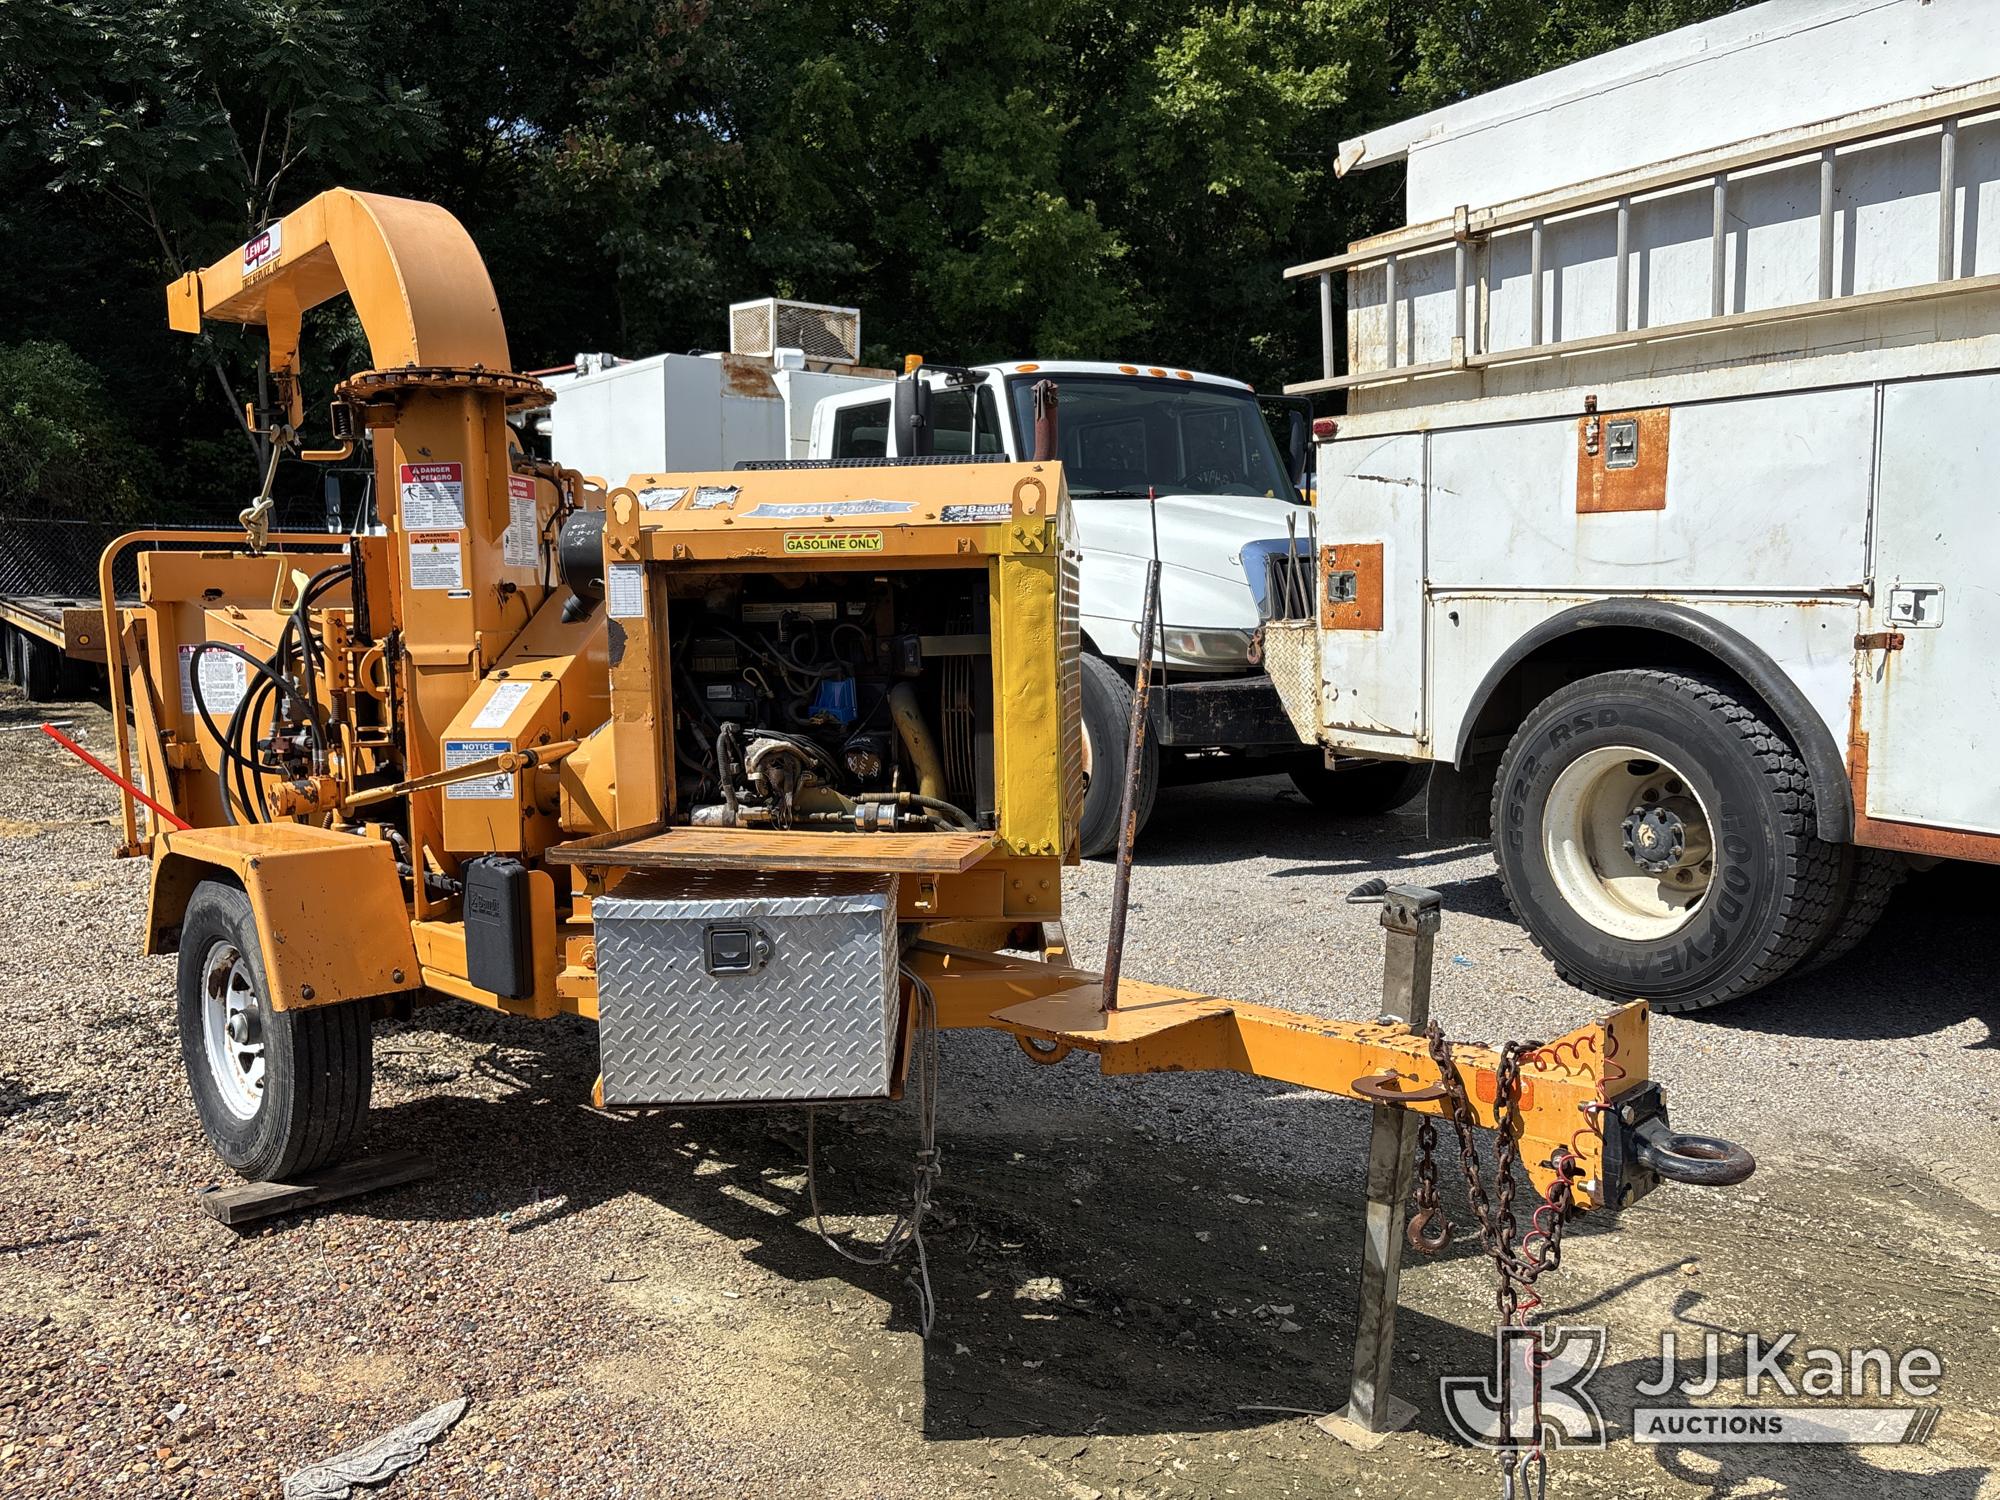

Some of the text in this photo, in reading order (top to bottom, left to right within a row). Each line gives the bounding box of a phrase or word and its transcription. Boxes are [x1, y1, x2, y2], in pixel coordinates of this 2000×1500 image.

[245, 236, 270, 261] LEWIS
[967, 503, 1010, 514] Bandit
[787, 538, 880, 551] GASOLINE ONLY
[1548, 708, 1620, 751] RSD
[1598, 800, 1753, 981] GOODYEAR
